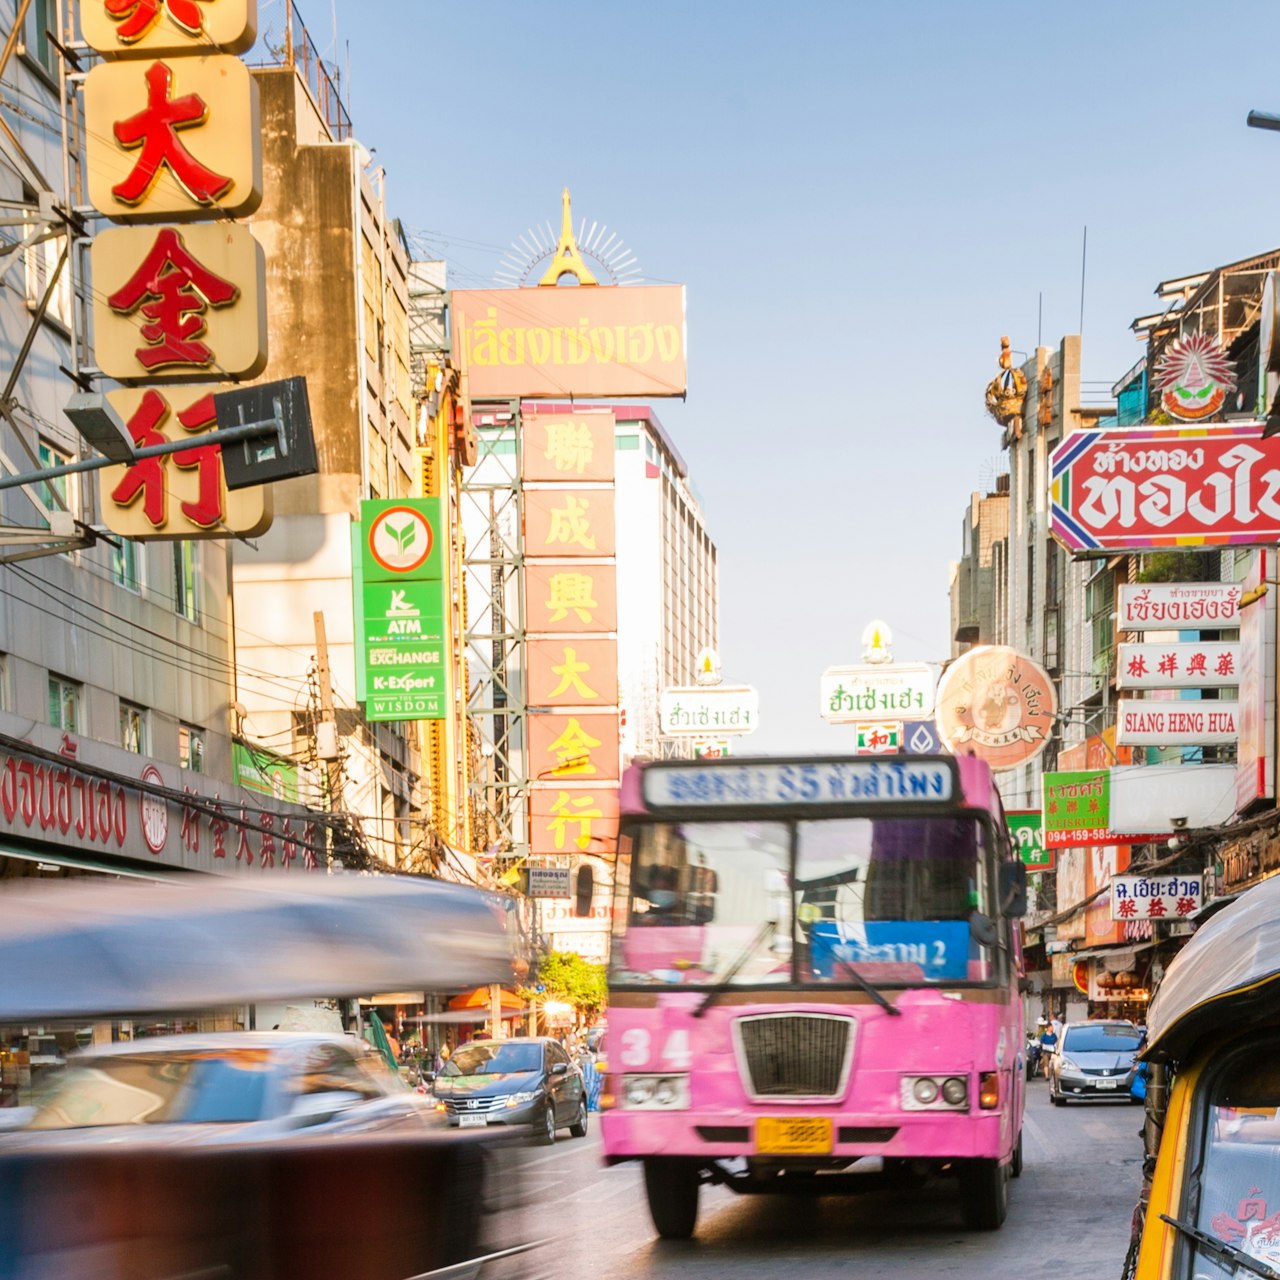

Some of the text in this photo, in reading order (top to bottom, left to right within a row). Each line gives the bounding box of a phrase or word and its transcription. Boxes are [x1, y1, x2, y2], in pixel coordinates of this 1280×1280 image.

[1093, 442, 1204, 472] ห้างทอง
[1126, 587, 1242, 621] เซี้ยงเฮงฮั่
[387, 620, 422, 634] ATM
[370, 652, 439, 666] EXCHANGE
[373, 672, 435, 692] K-Expert
[374, 702, 438, 712] WISDOM
[1125, 713, 1235, 732] SIANG HENG HUA
[868, 731, 888, 749] 和
[1049, 776, 1105, 798] เวชศรี
[933, 940, 947, 965] 2
[621, 1028, 693, 1067] 34
